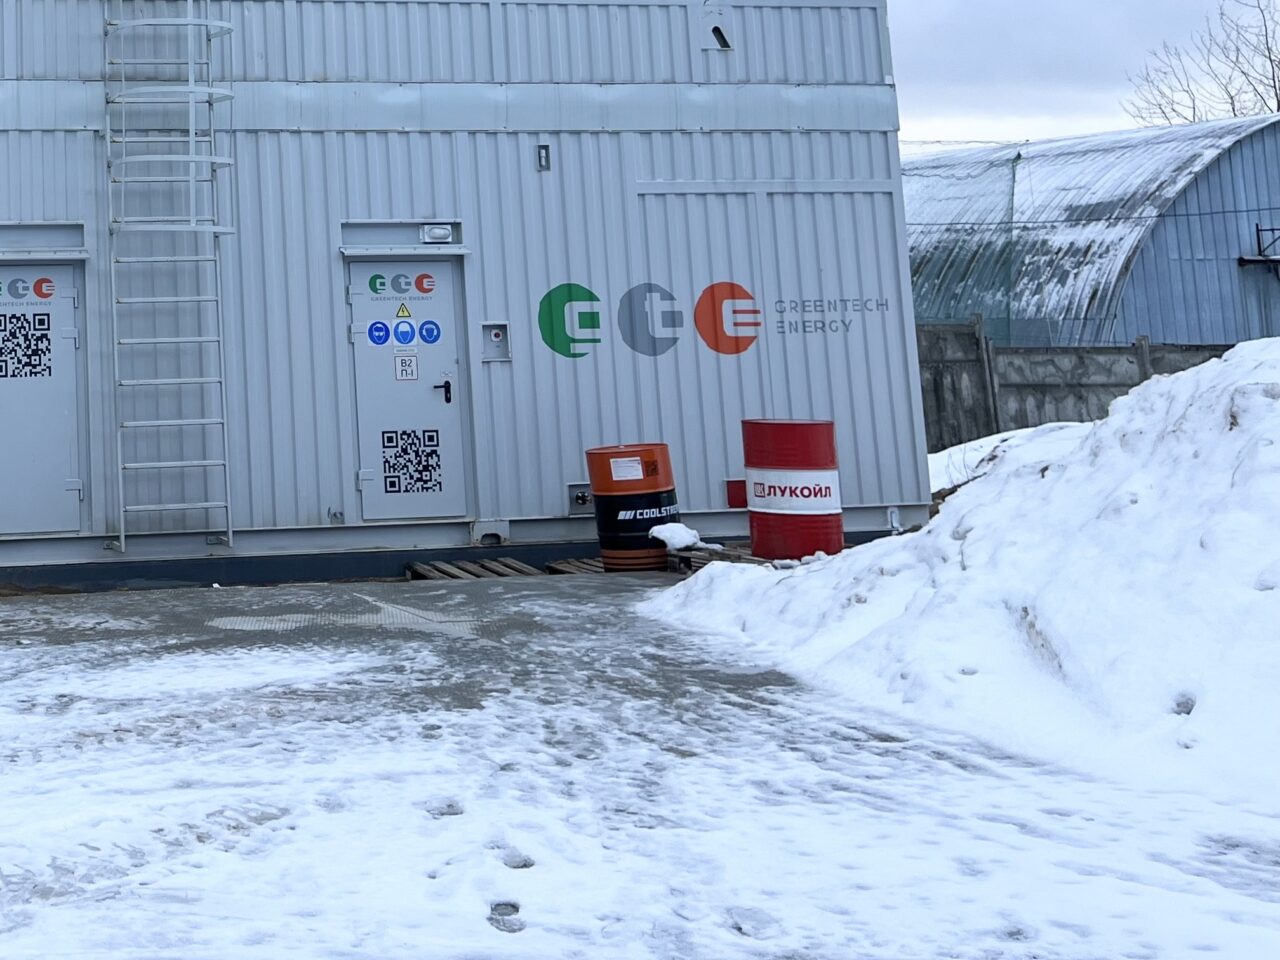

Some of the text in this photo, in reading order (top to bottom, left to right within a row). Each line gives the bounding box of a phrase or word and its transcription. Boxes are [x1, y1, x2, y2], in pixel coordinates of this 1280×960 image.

[775, 298, 889, 313] GREENTECH
[776, 319, 853, 334] ENERGY
[767, 484, 832, 499] ЛУКОЙЛ
